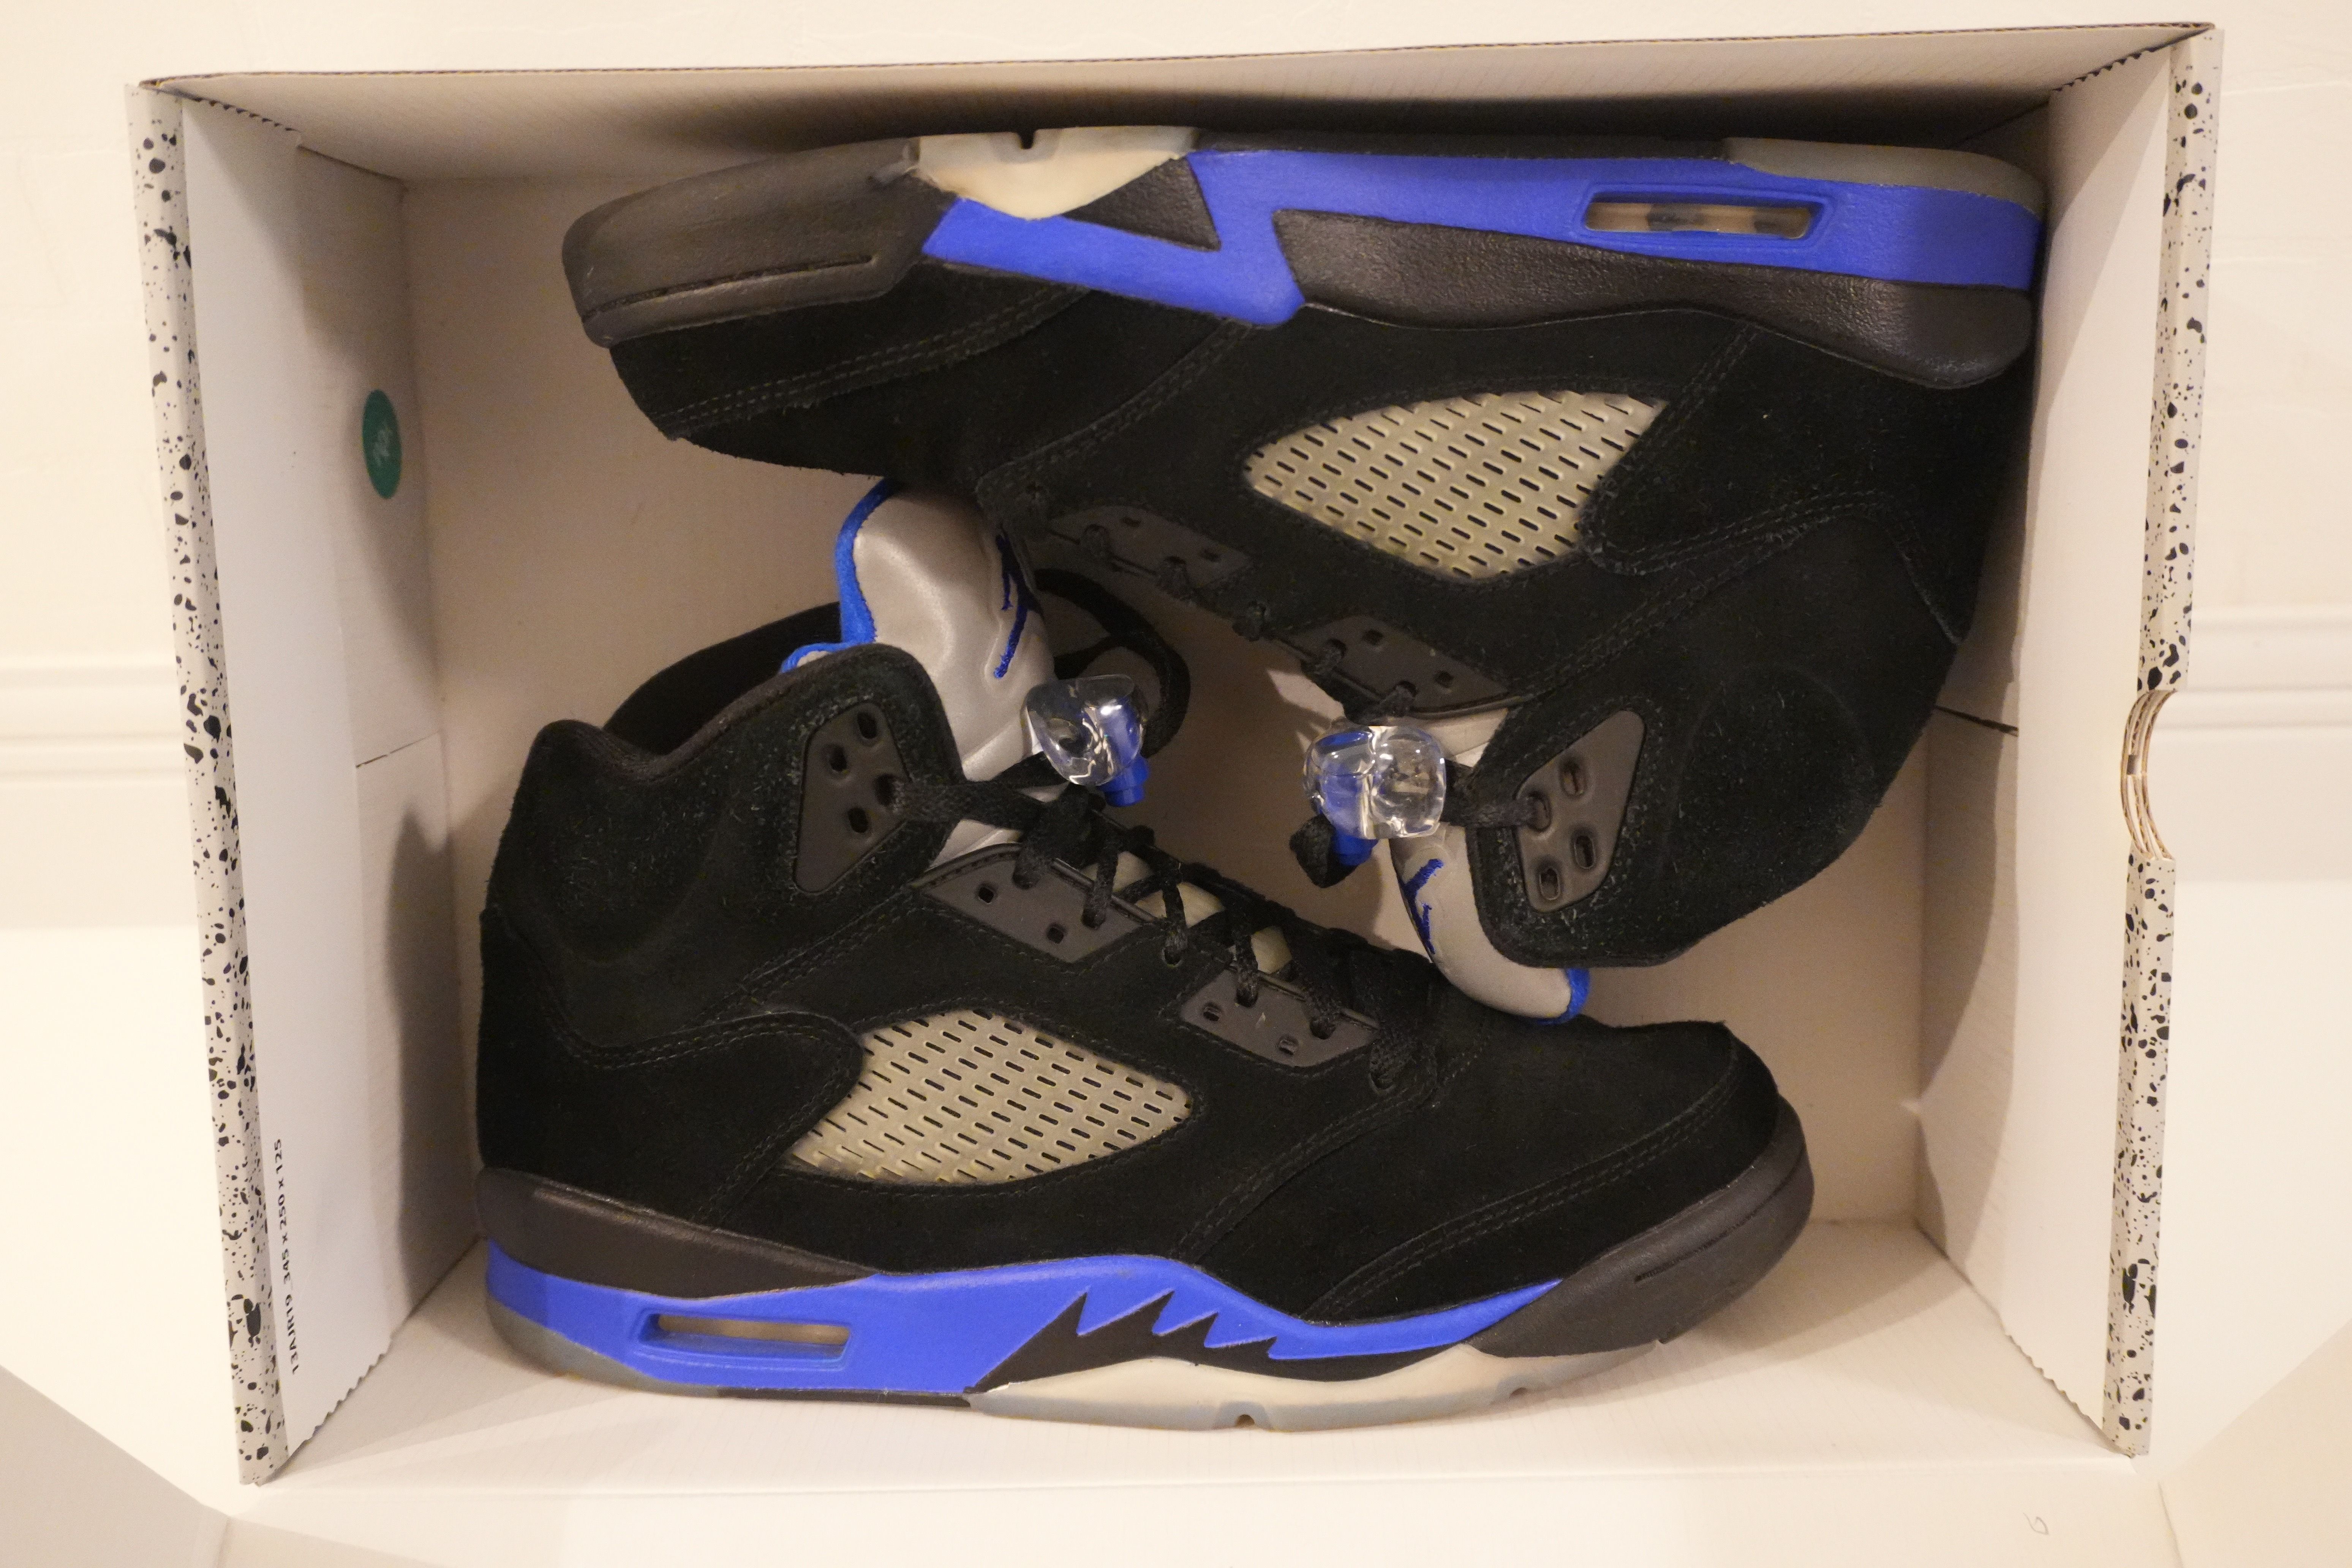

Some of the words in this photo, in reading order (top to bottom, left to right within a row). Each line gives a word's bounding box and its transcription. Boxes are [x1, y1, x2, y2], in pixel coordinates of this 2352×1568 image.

[274, 1139, 283, 1174] 125
[278, 1178, 284, 1189] x
[278, 1194, 287, 1230] 250
[282, 1233, 288, 1245] x
